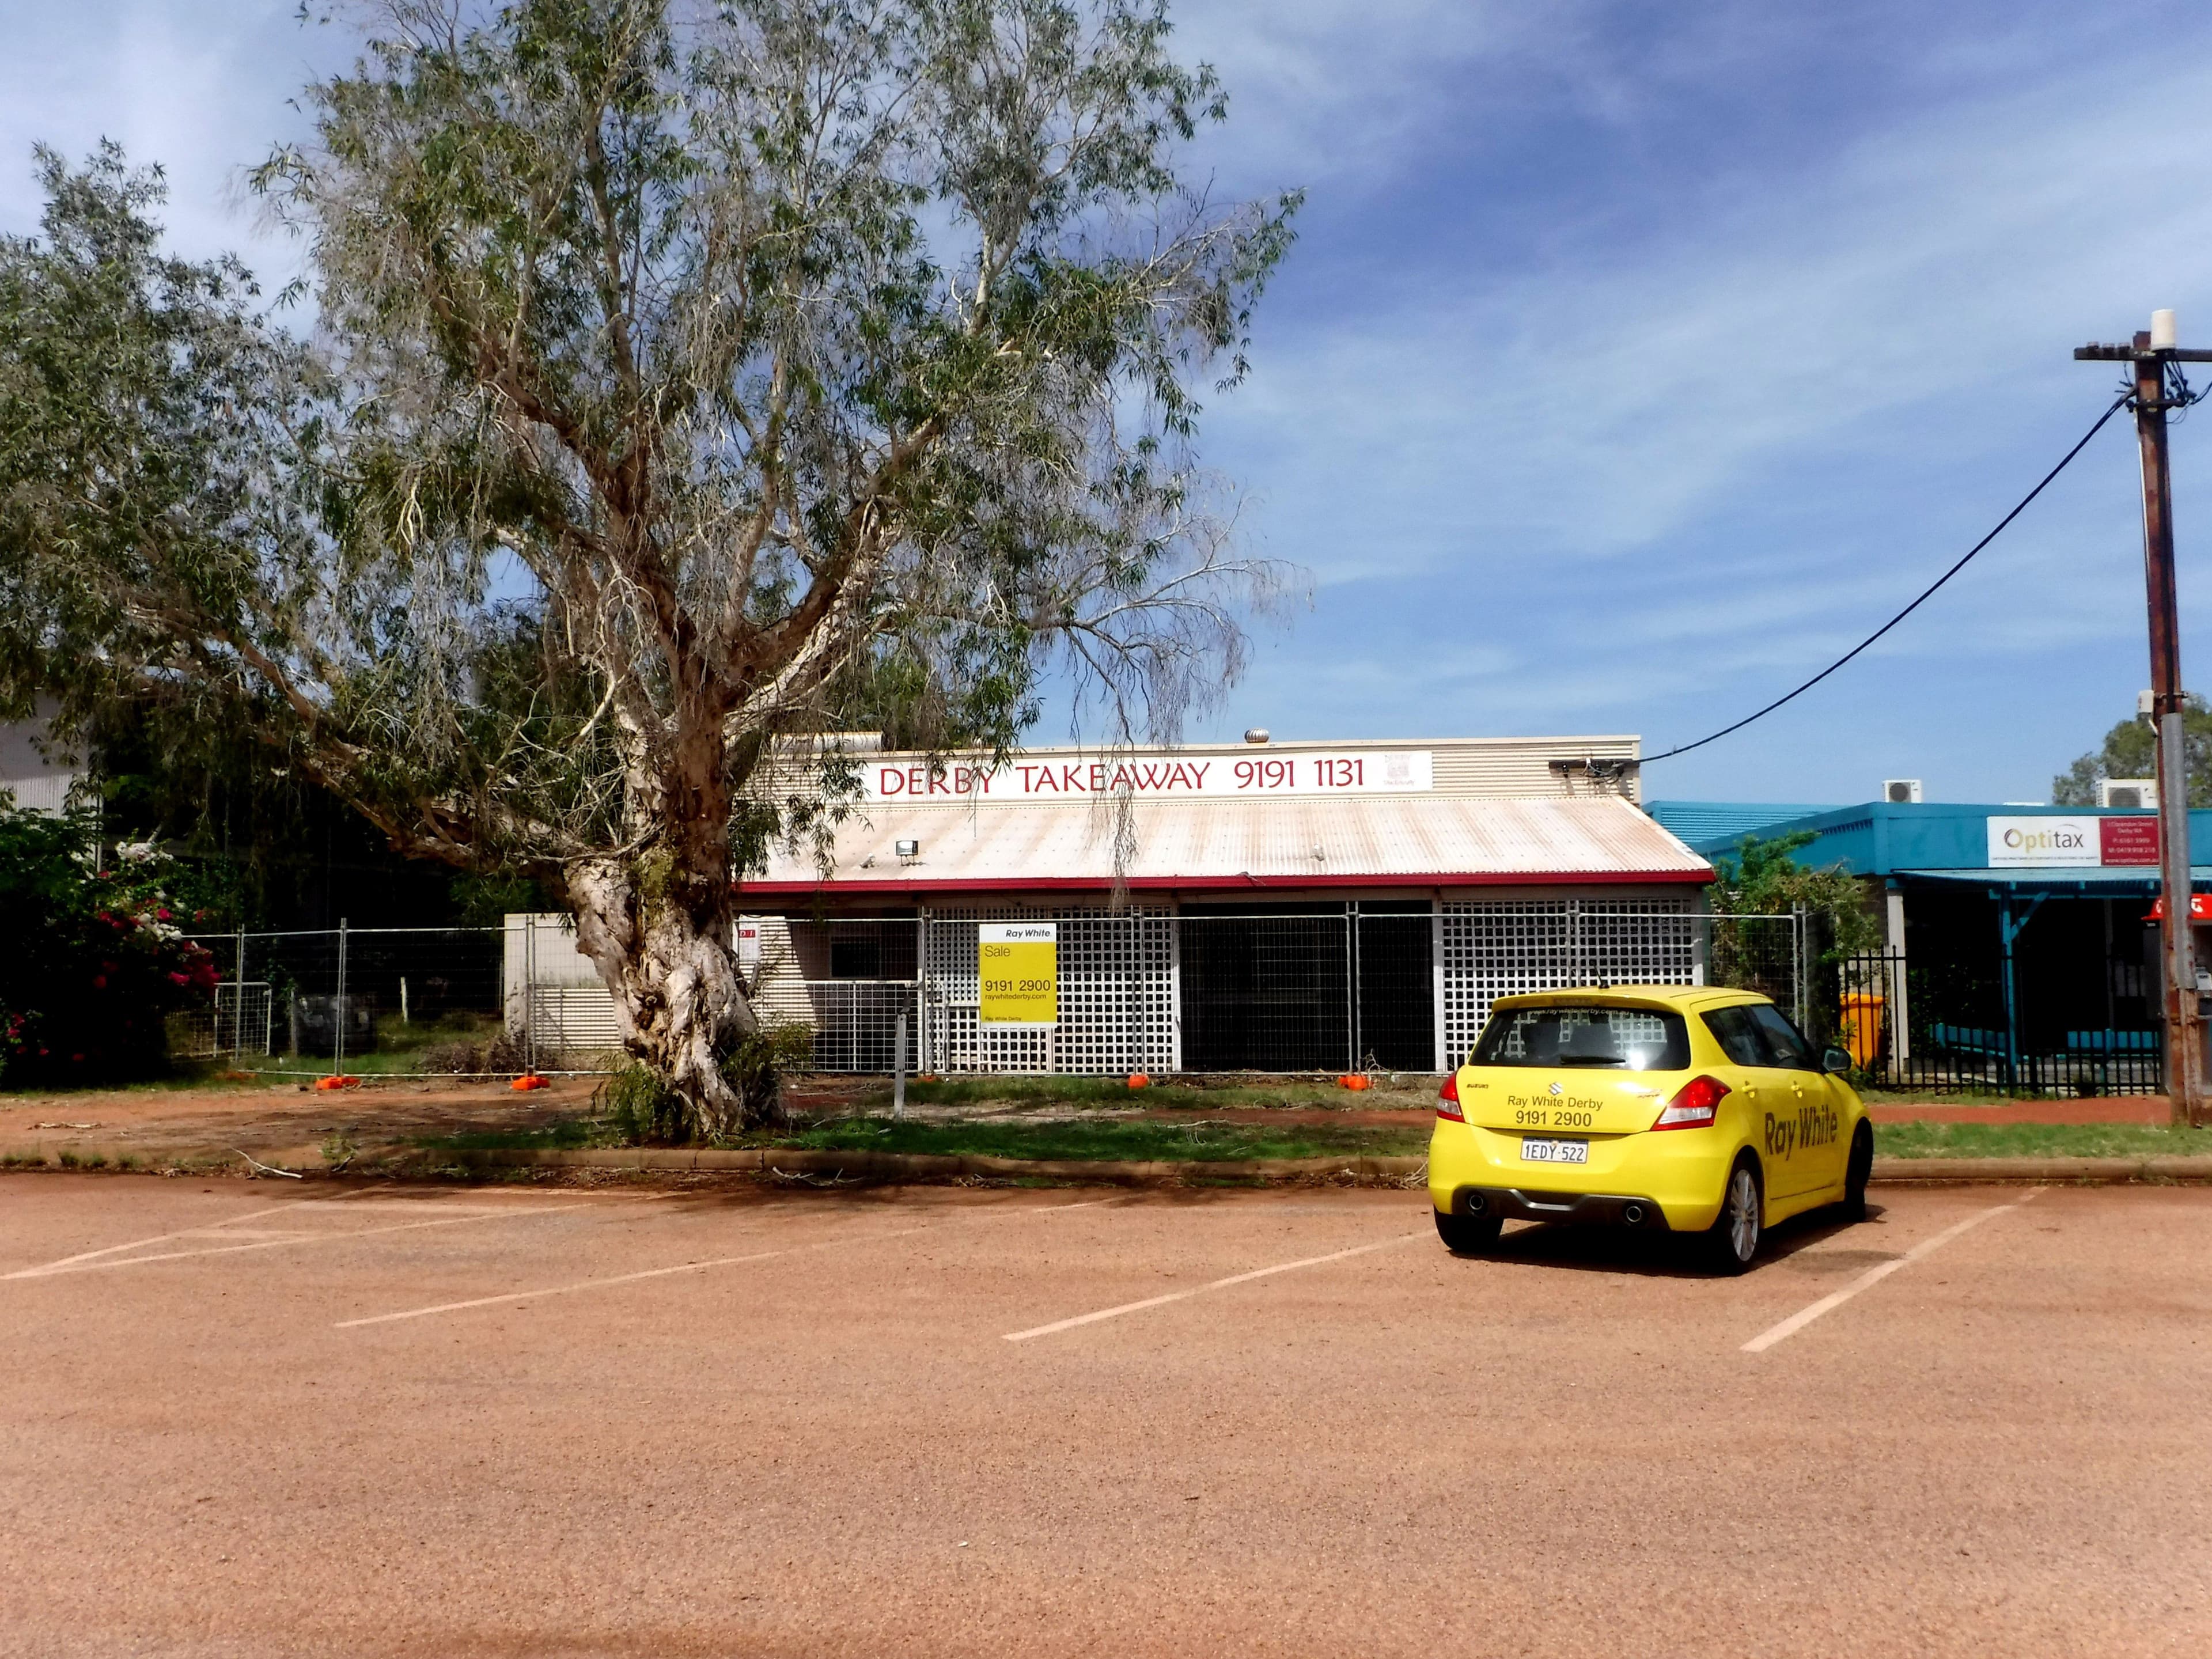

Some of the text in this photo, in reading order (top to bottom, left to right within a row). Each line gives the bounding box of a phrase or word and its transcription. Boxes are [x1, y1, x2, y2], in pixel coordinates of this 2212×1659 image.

[880, 759, 1363, 796] DERBY TAKEAWAY 9191 1131
[2003, 828, 2084, 853] Optitax
[1006, 929, 1051, 939] Ray White
[984, 945, 1011, 957] Sale
[985, 979, 1051, 992] 9191 2900
[1508, 1096, 1603, 1111] Ray White Derby
[1516, 1110, 1592, 1127] 9191 2900
[1764, 1104, 1837, 1161] Ray White
